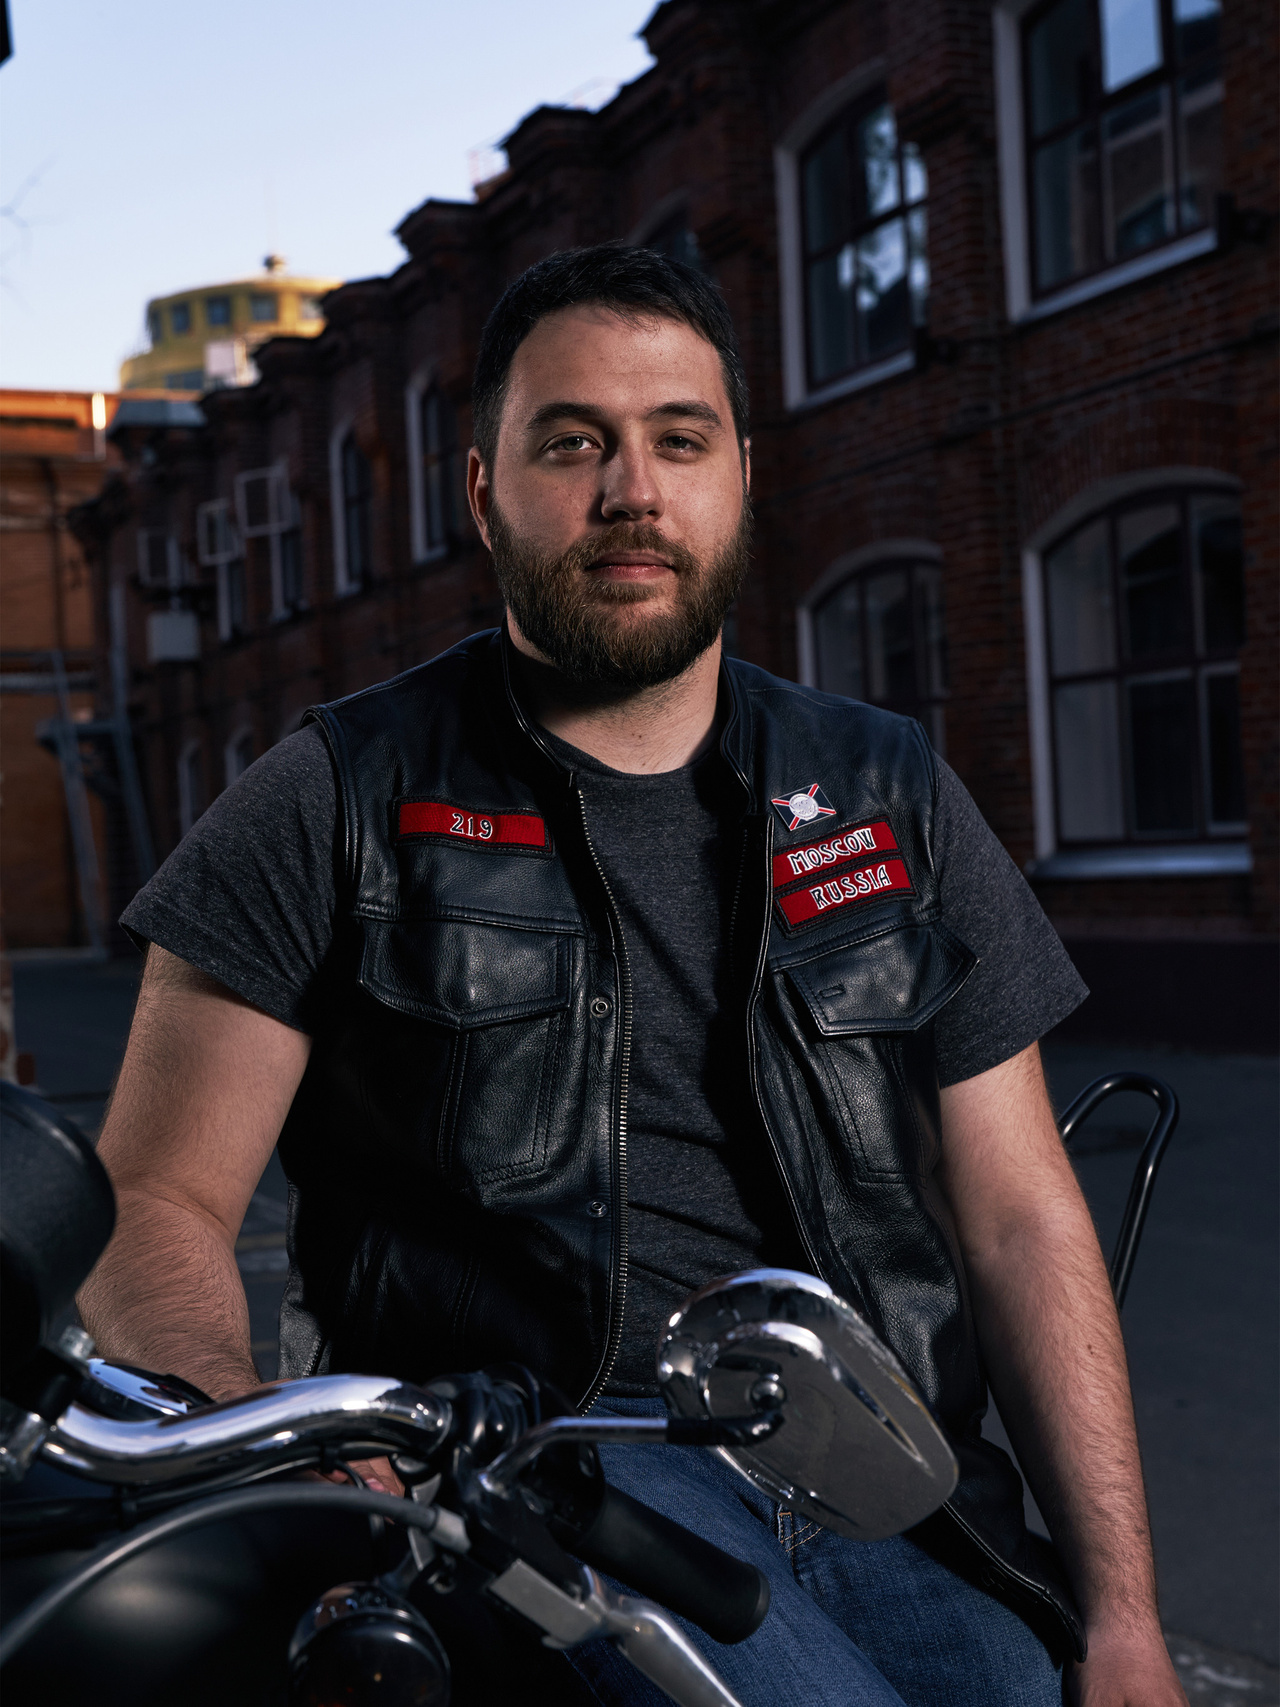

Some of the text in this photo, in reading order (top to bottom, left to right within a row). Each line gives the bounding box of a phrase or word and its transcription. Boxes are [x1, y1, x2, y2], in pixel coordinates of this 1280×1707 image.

[450, 813, 493, 839] 219
[787, 827, 877, 876] MOSCOW
[809, 864, 892, 910] RUSSIA
